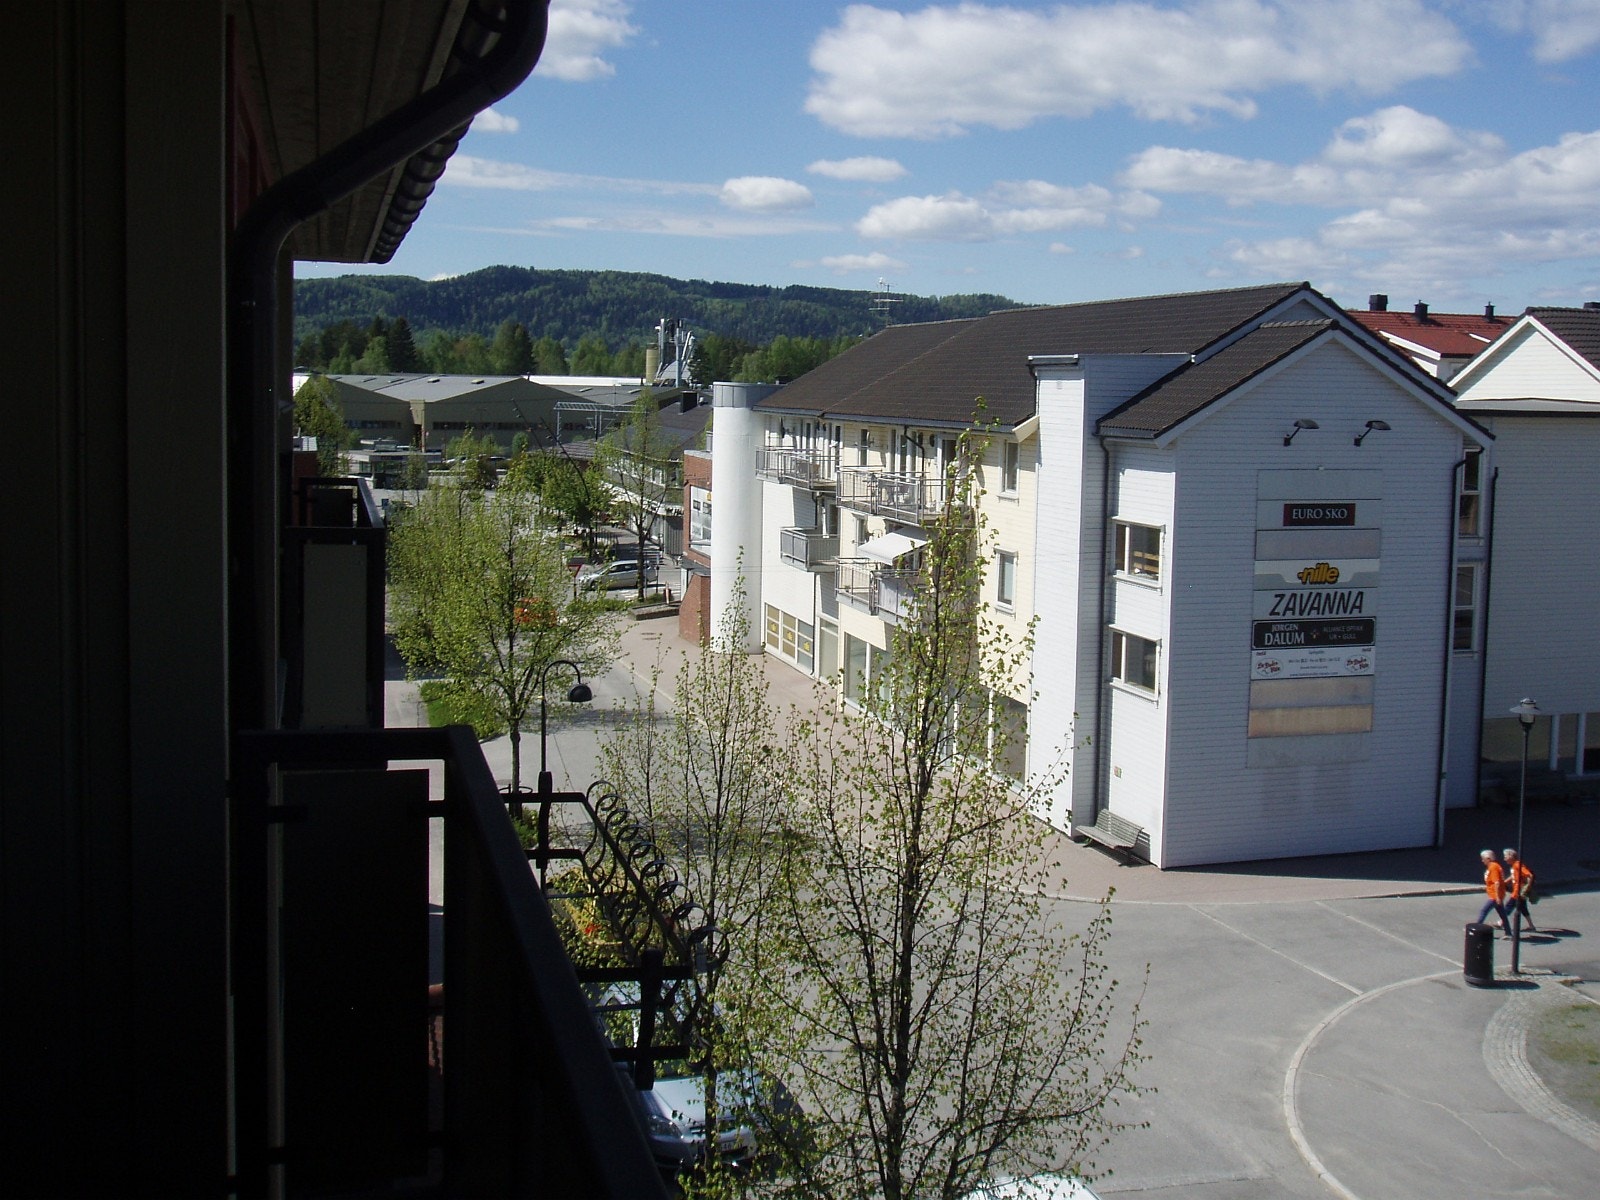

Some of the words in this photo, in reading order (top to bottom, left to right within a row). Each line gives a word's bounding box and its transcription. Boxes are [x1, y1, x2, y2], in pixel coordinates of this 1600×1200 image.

[1292, 508, 1323, 519] EURO
[1325, 508, 1347, 519] SKO
[1298, 562, 1339, 585] nille
[1269, 591, 1365, 617] ZAVANNA
[1264, 632, 1305, 645] DALUM
